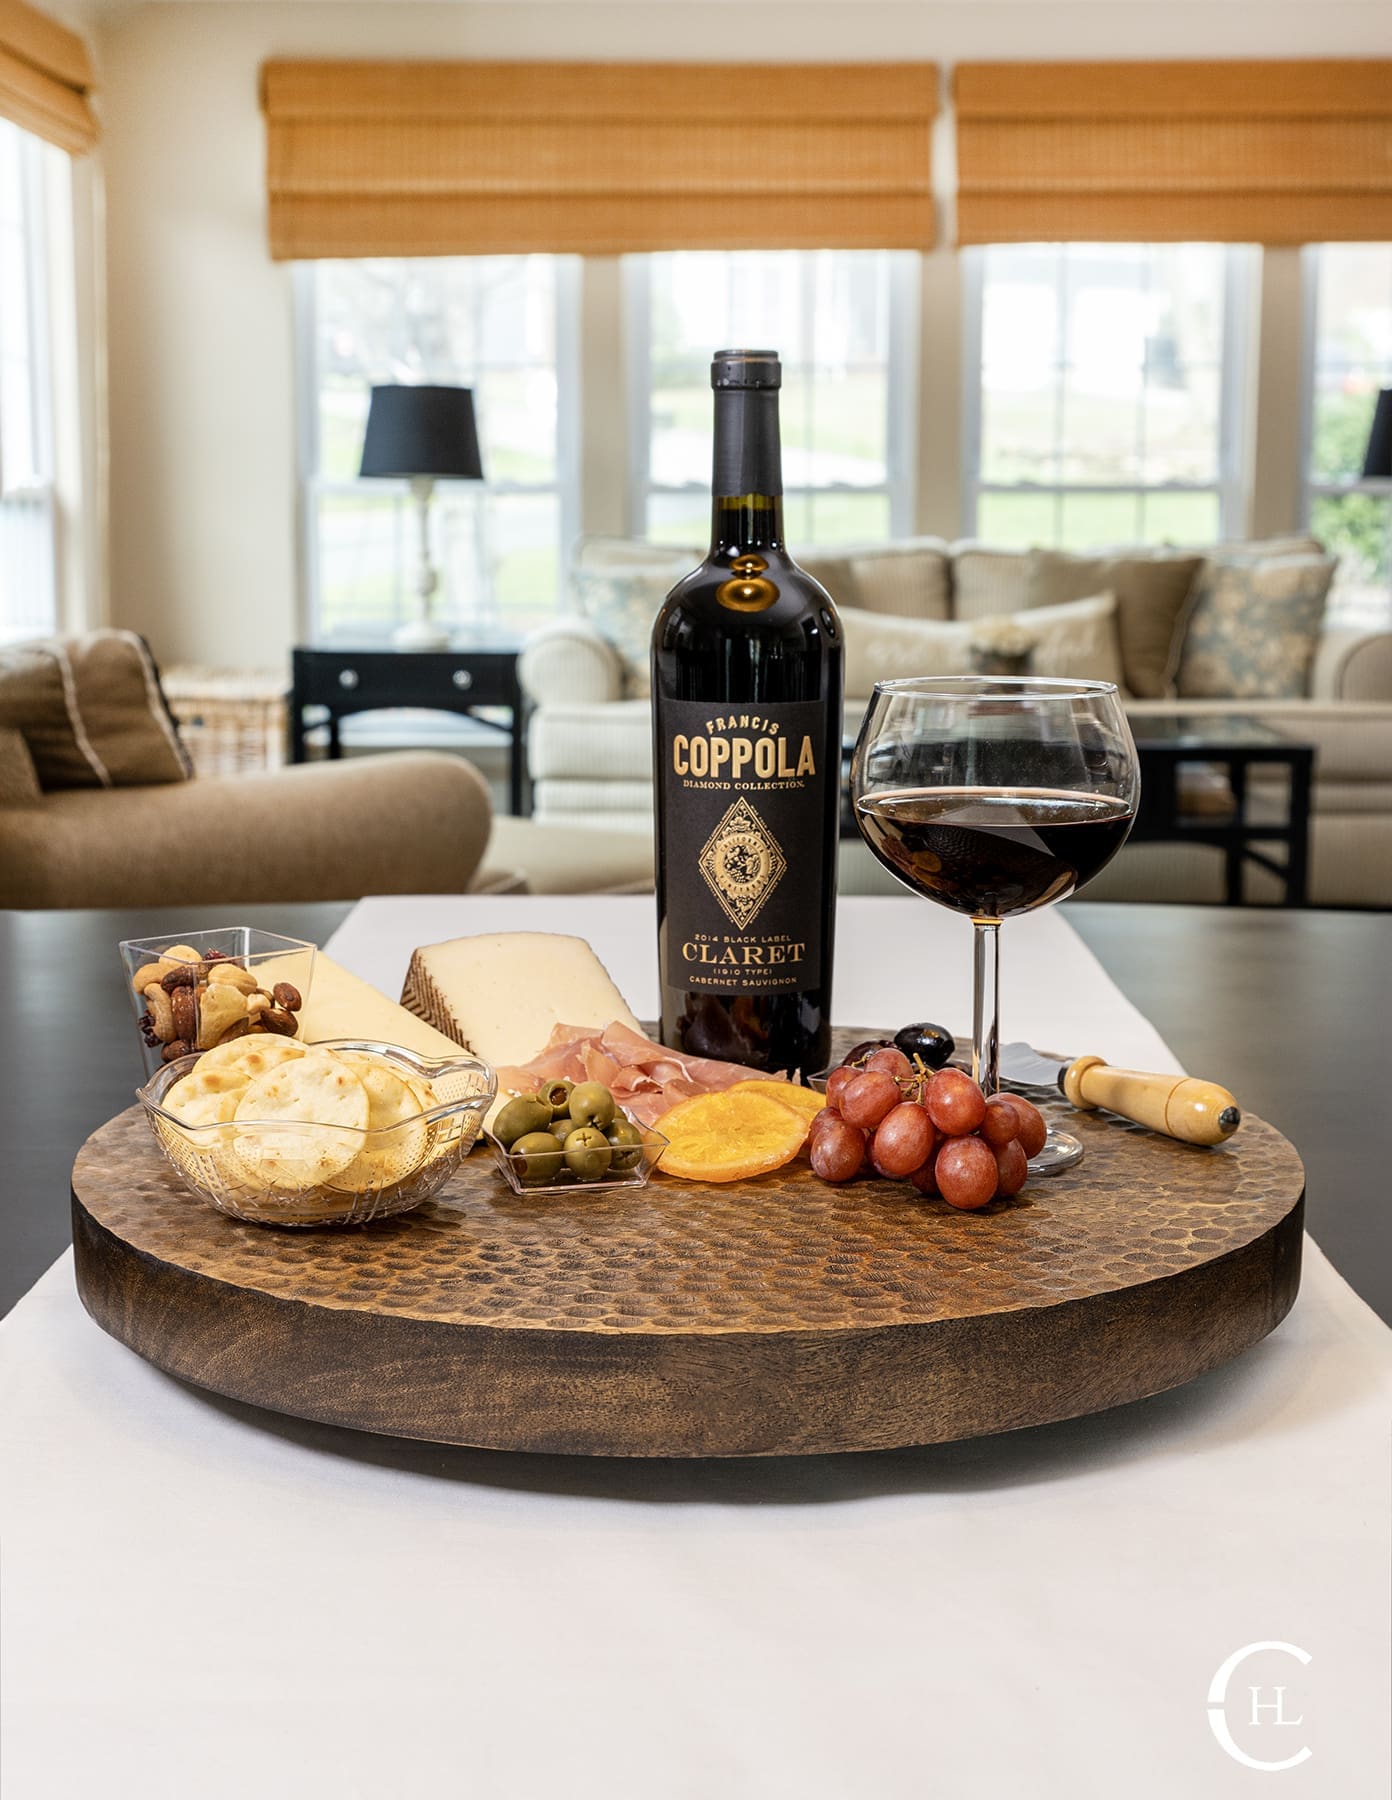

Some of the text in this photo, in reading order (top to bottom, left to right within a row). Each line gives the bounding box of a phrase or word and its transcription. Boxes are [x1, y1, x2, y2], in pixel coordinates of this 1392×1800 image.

[705, 715, 780, 735] FRANCIS
[673, 734, 816, 778] COPPOLA
[683, 779, 731, 790] DIAMOND
[694, 934, 718, 942] 2014
[762, 935, 792, 943] LABEL
[682, 942, 805, 965] CLARET
[689, 975, 797, 986] CABERNET SAUVIGNON
